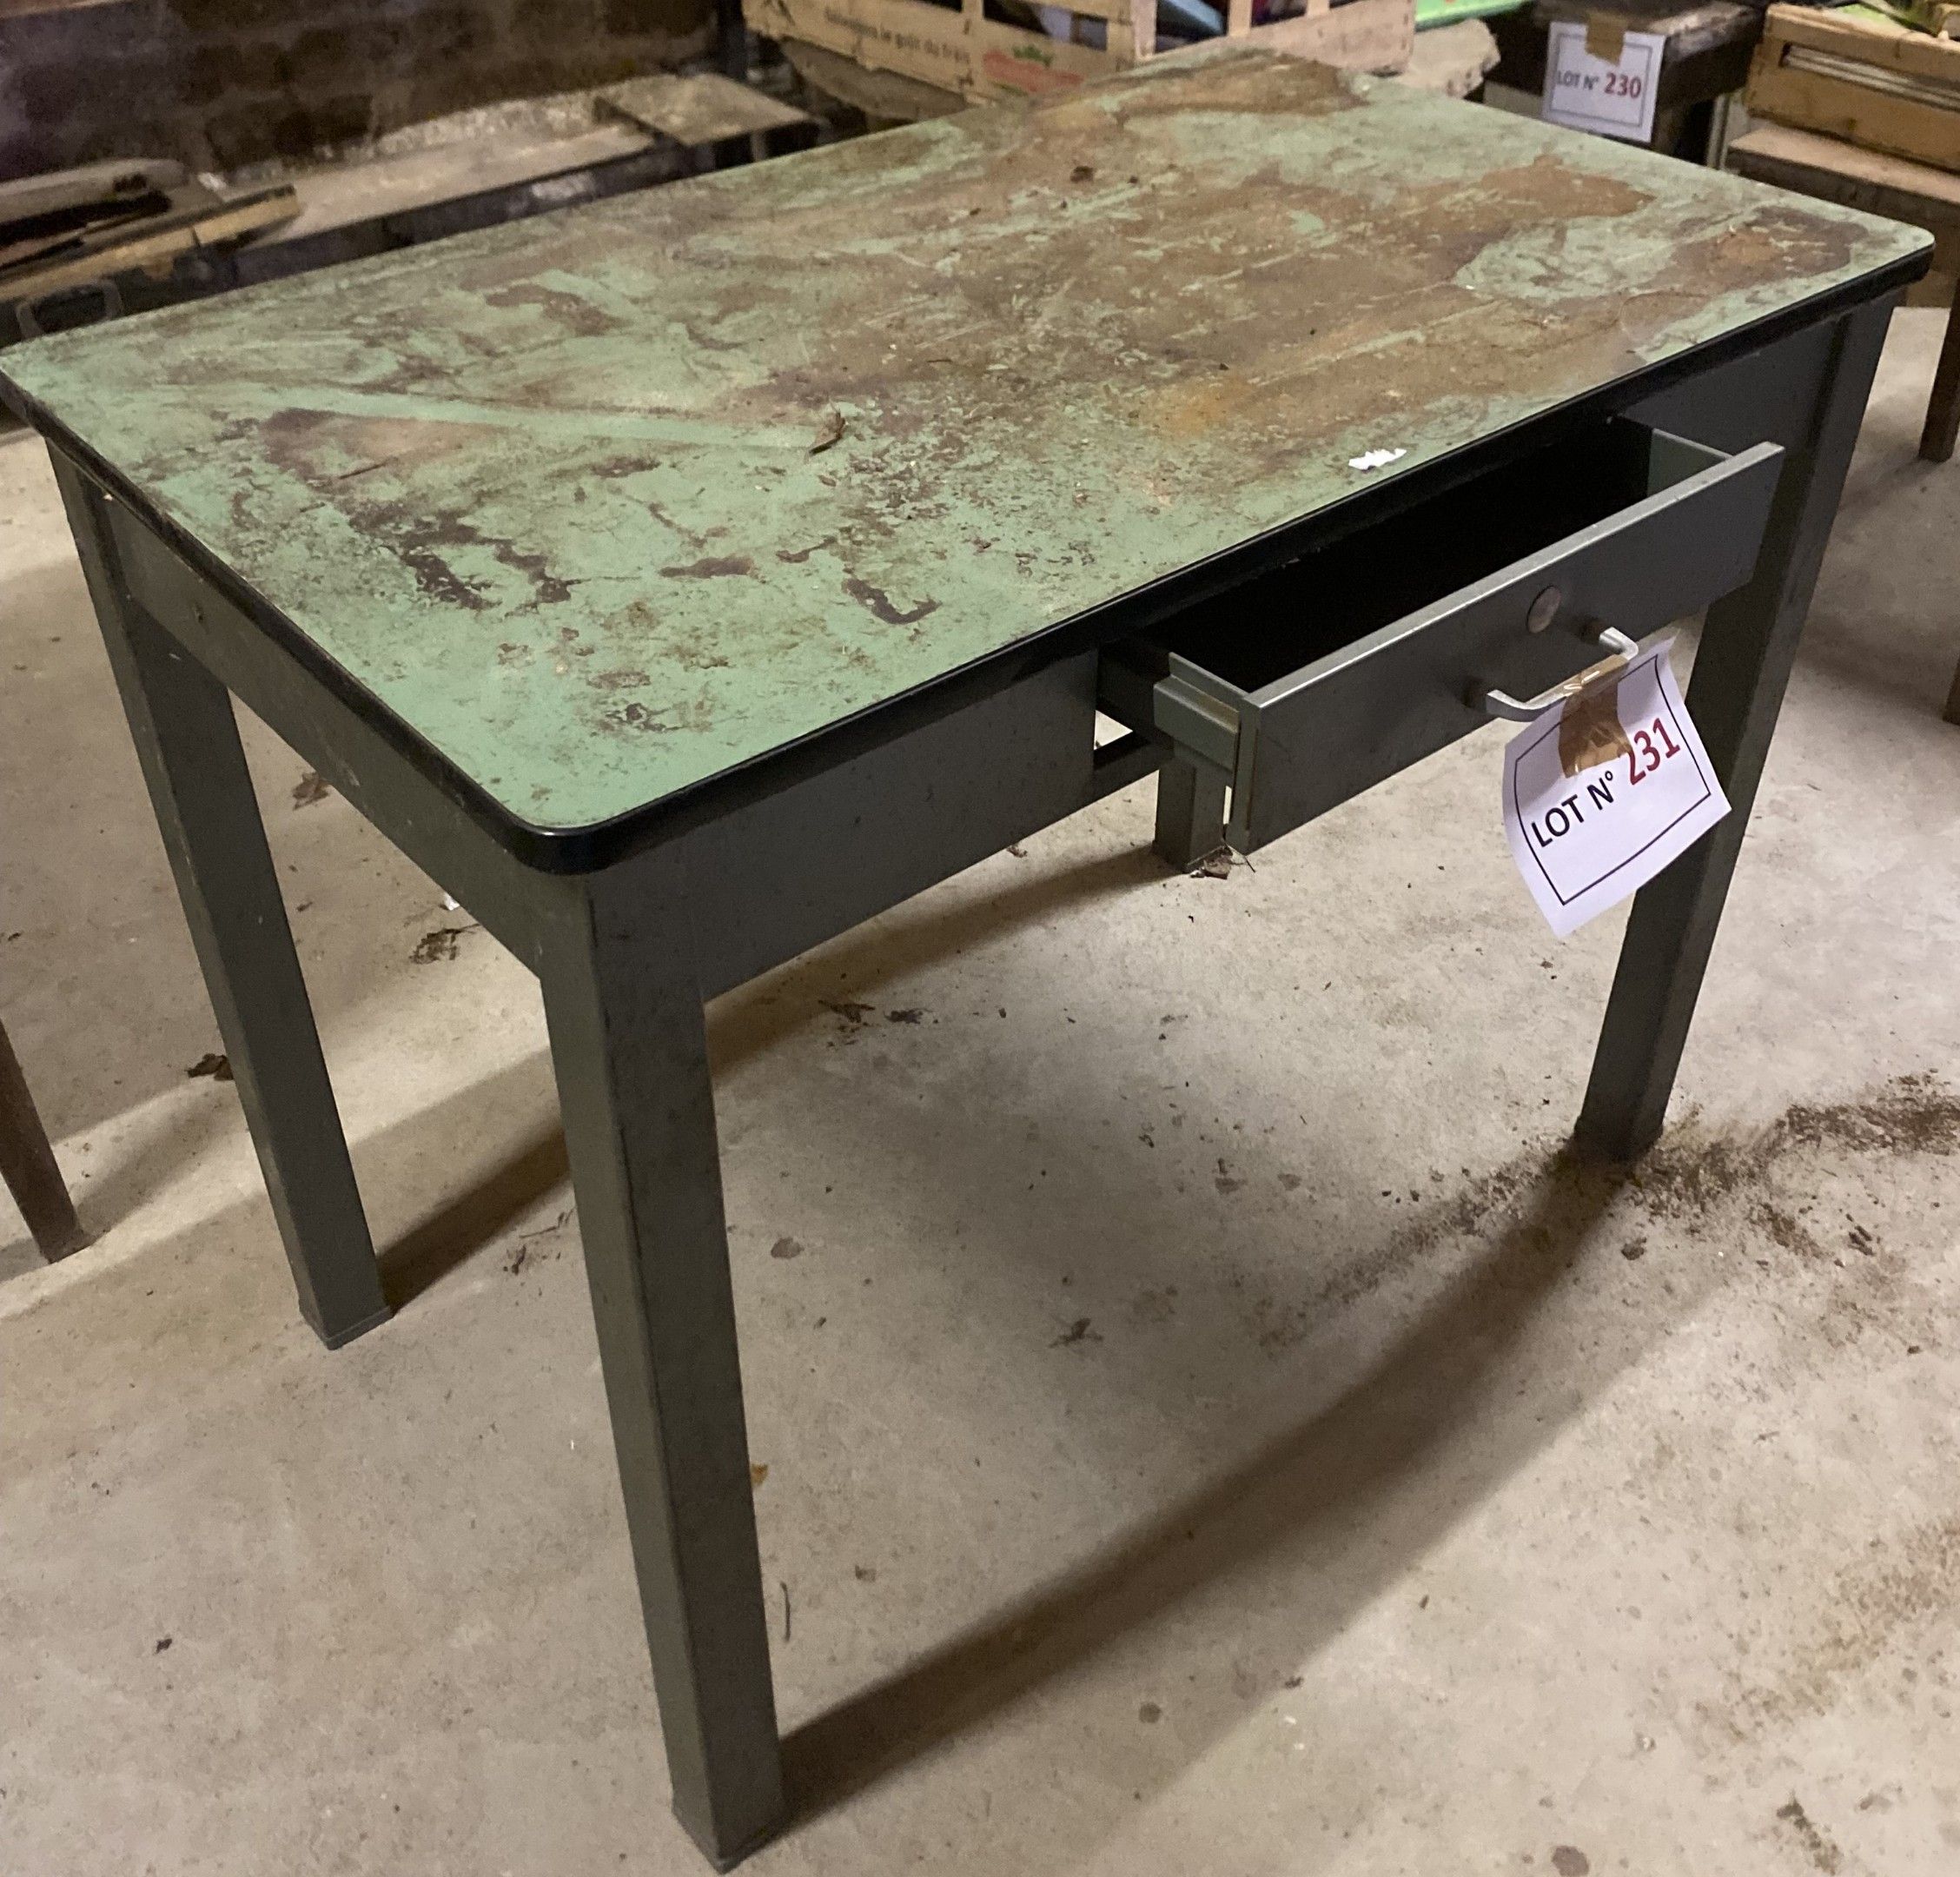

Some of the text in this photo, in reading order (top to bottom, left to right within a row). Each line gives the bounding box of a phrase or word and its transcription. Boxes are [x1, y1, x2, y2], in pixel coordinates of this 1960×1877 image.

[1557, 70, 1580, 88] LOT
[1604, 71, 1642, 99] 230
[1530, 793, 1585, 848] LOT
[1618, 717, 1681, 786] 231
